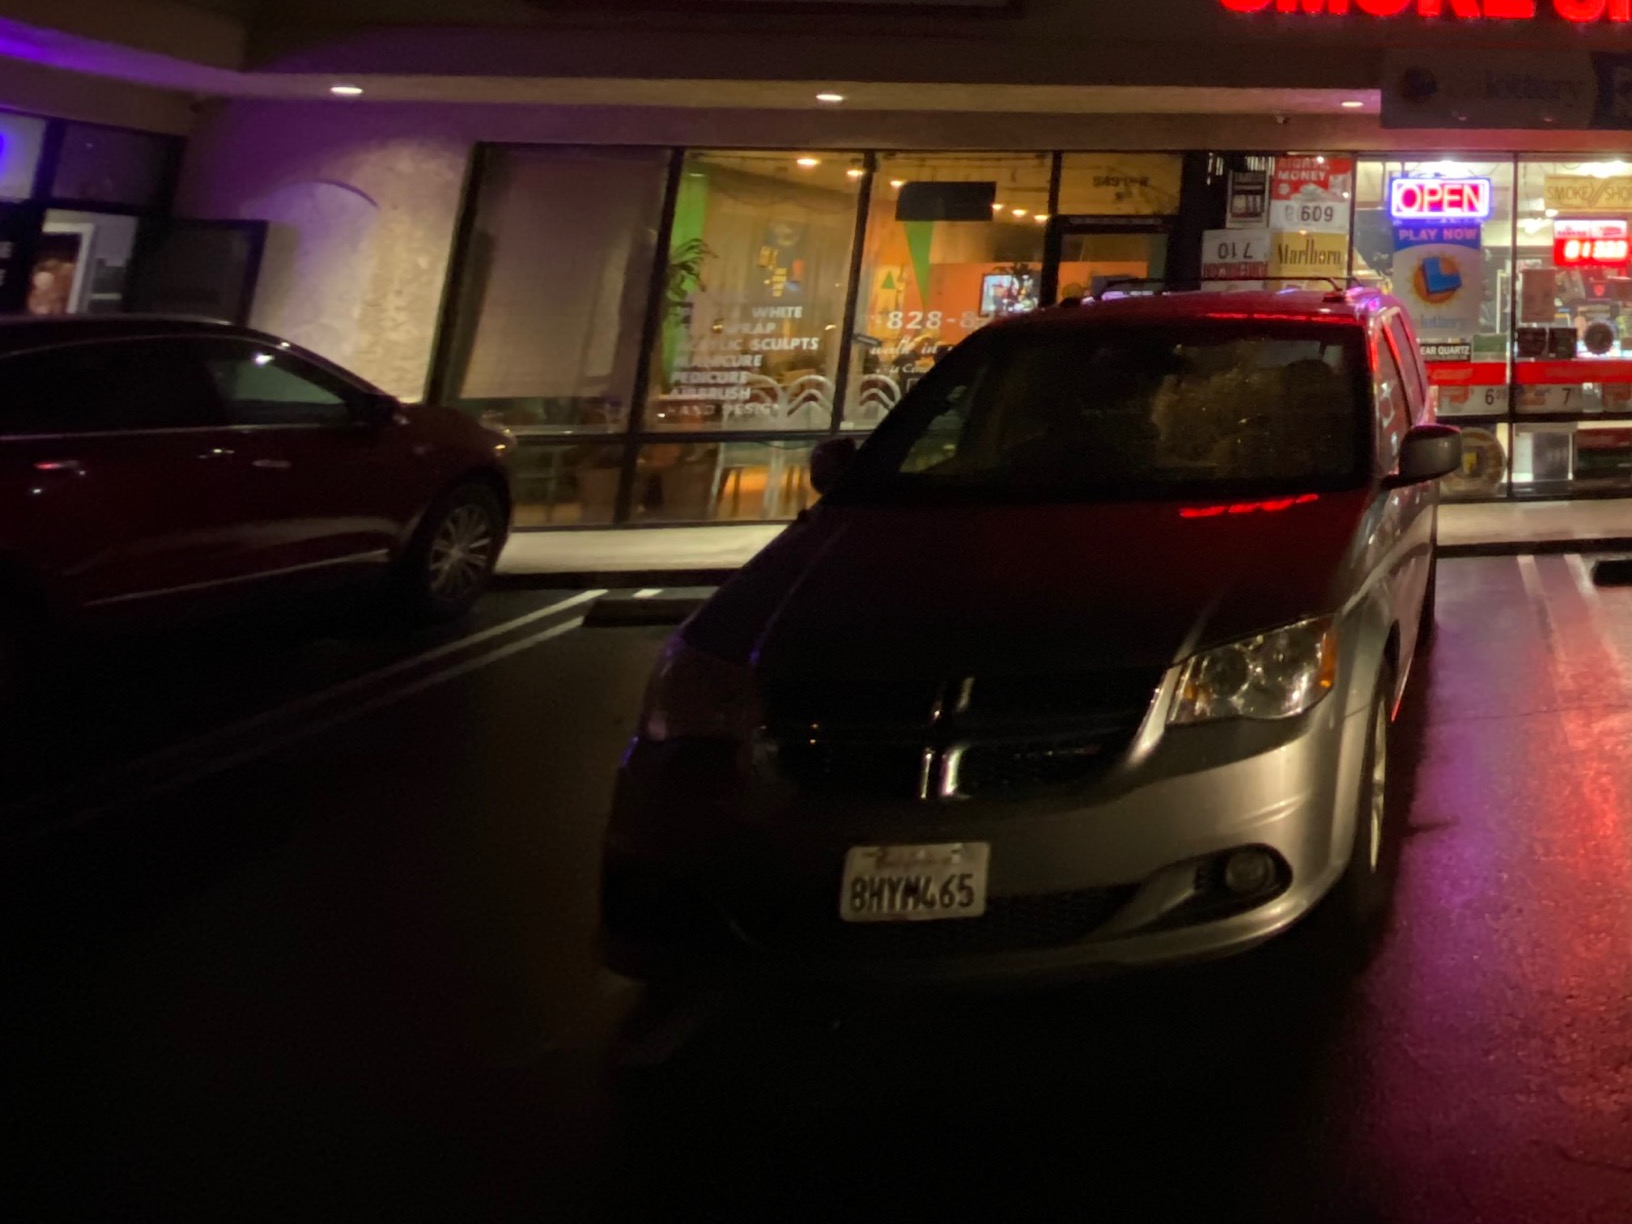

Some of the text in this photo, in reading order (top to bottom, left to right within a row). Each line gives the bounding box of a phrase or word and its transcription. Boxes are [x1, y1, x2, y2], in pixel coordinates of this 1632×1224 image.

[1278, 170, 1327, 181] MONEY
[1397, 183, 1485, 213] OPEN
[1547, 185, 1589, 202] SMOKE
[1399, 227, 1477, 241] PLAY NOW
[1278, 238, 1342, 265] Marlboro
[752, 305, 803, 319] WHITE
[751, 337, 820, 351] SCULPTS
[1438, 345, 1471, 356] QUARTZ
[669, 387, 752, 400] AIRBRUSH
